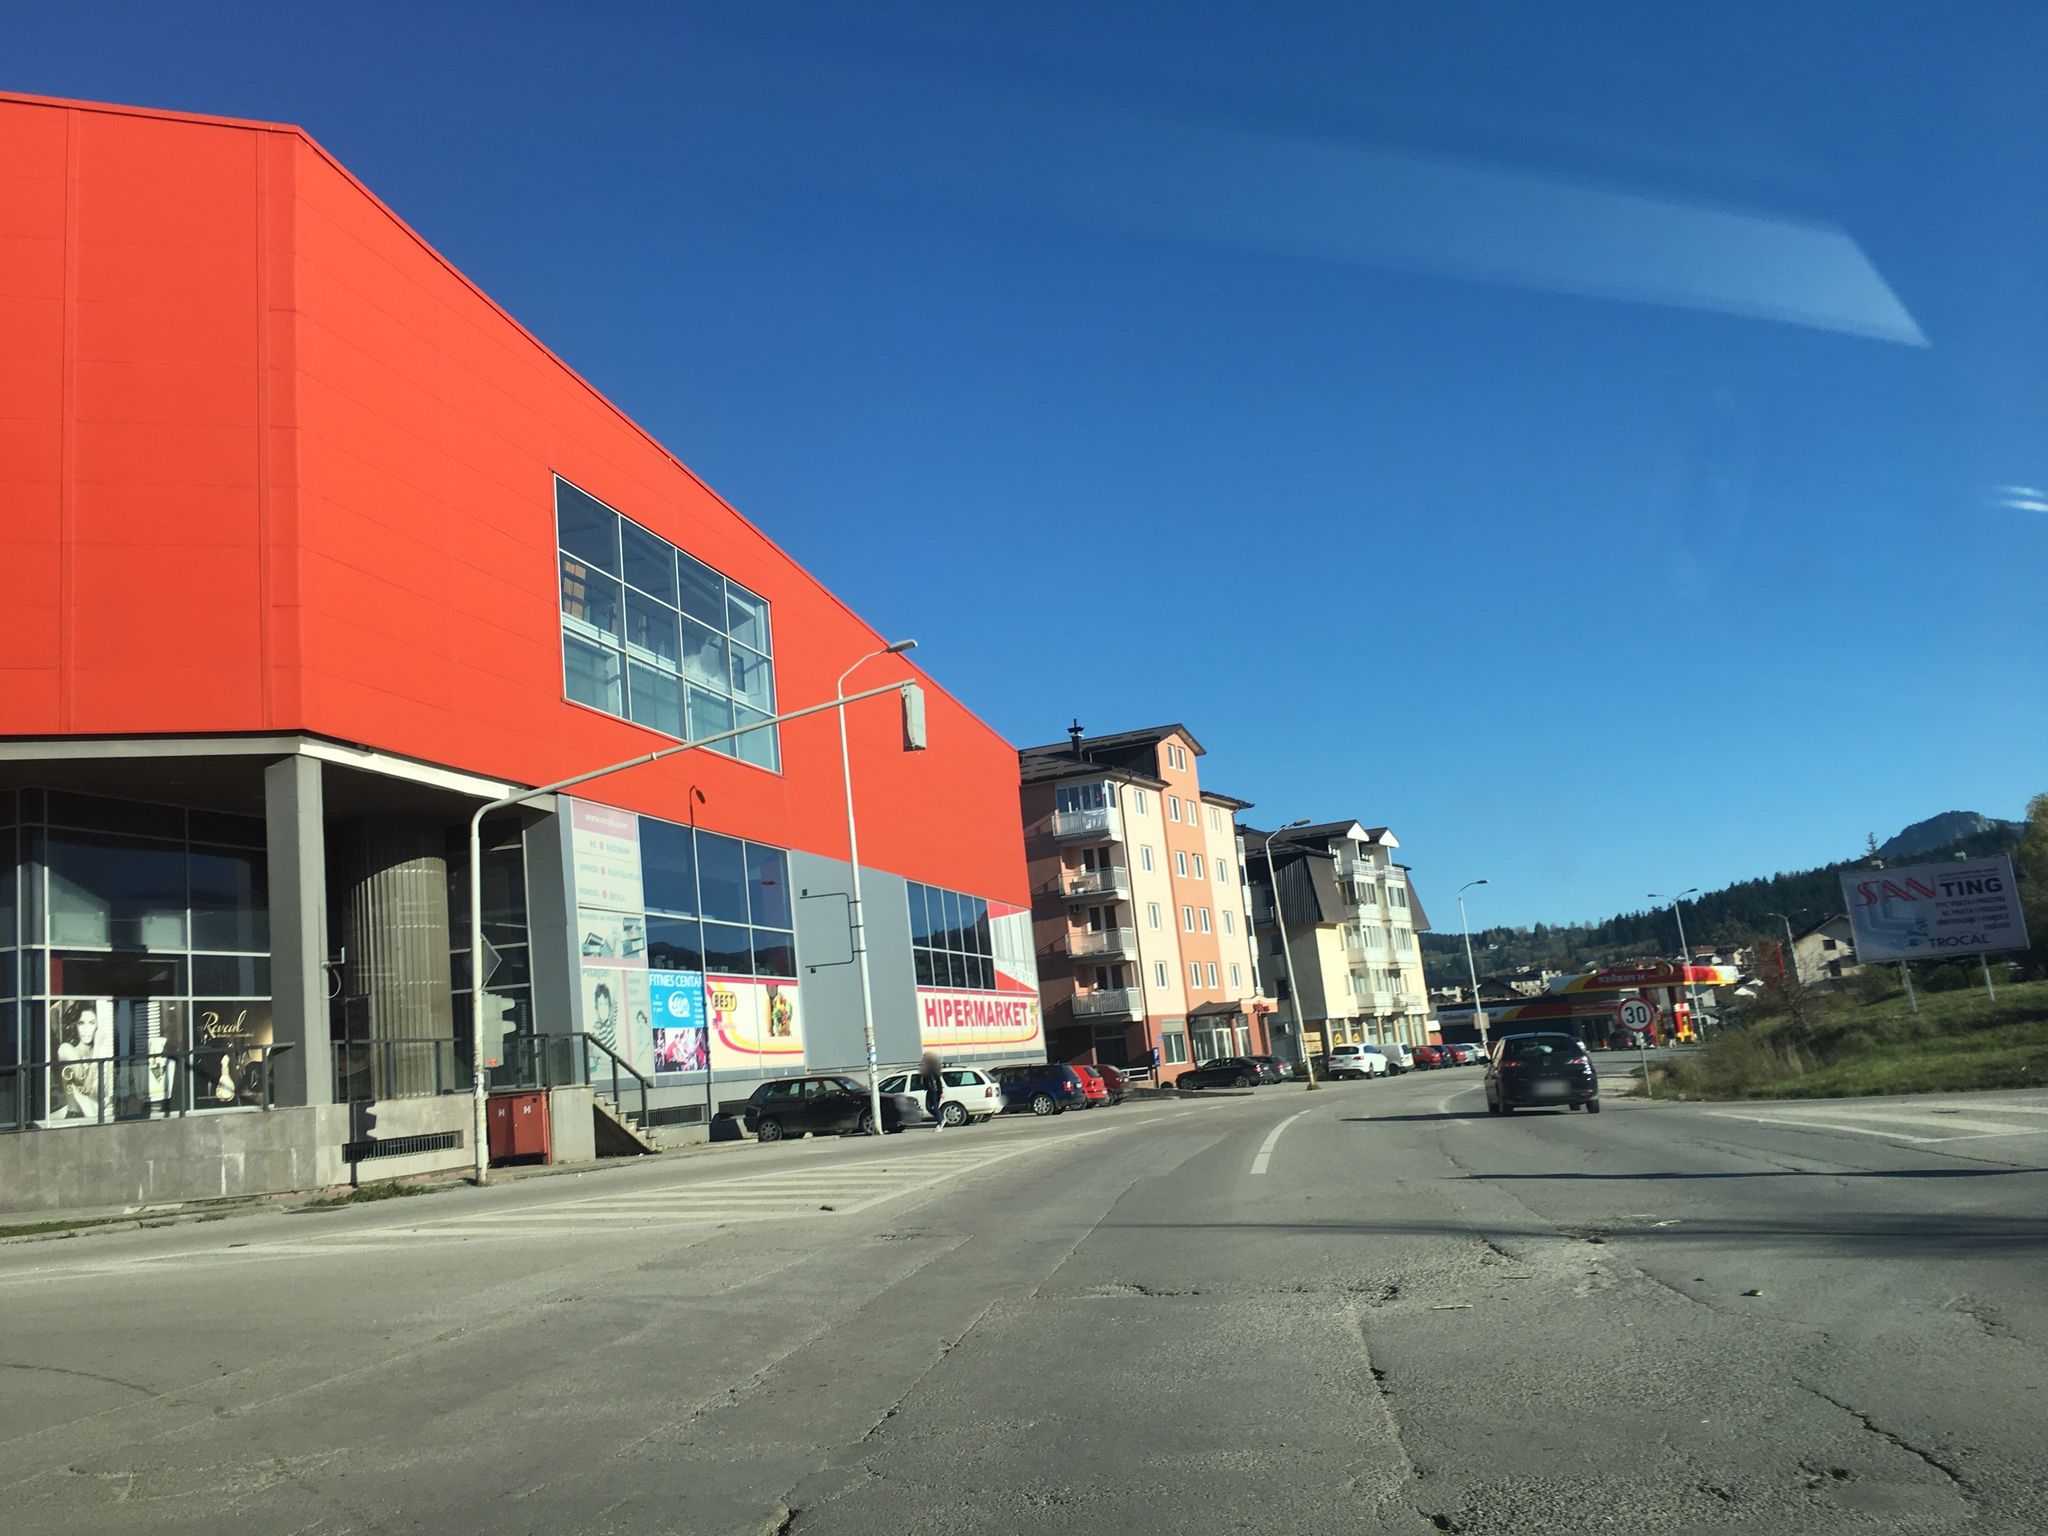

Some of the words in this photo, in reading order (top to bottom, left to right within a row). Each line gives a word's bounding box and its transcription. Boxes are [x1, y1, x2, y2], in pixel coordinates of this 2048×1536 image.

[1939, 877, 2003, 897] TING
[1928, 934, 1989, 948] TROCAL
[649, 974, 675, 987] FITNES
[714, 995, 734, 1008] BEST
[924, 998, 1028, 1027] HIPERMARKET
[1625, 1005, 1647, 1024] 30
[201, 1010, 248, 1039] Reveal
